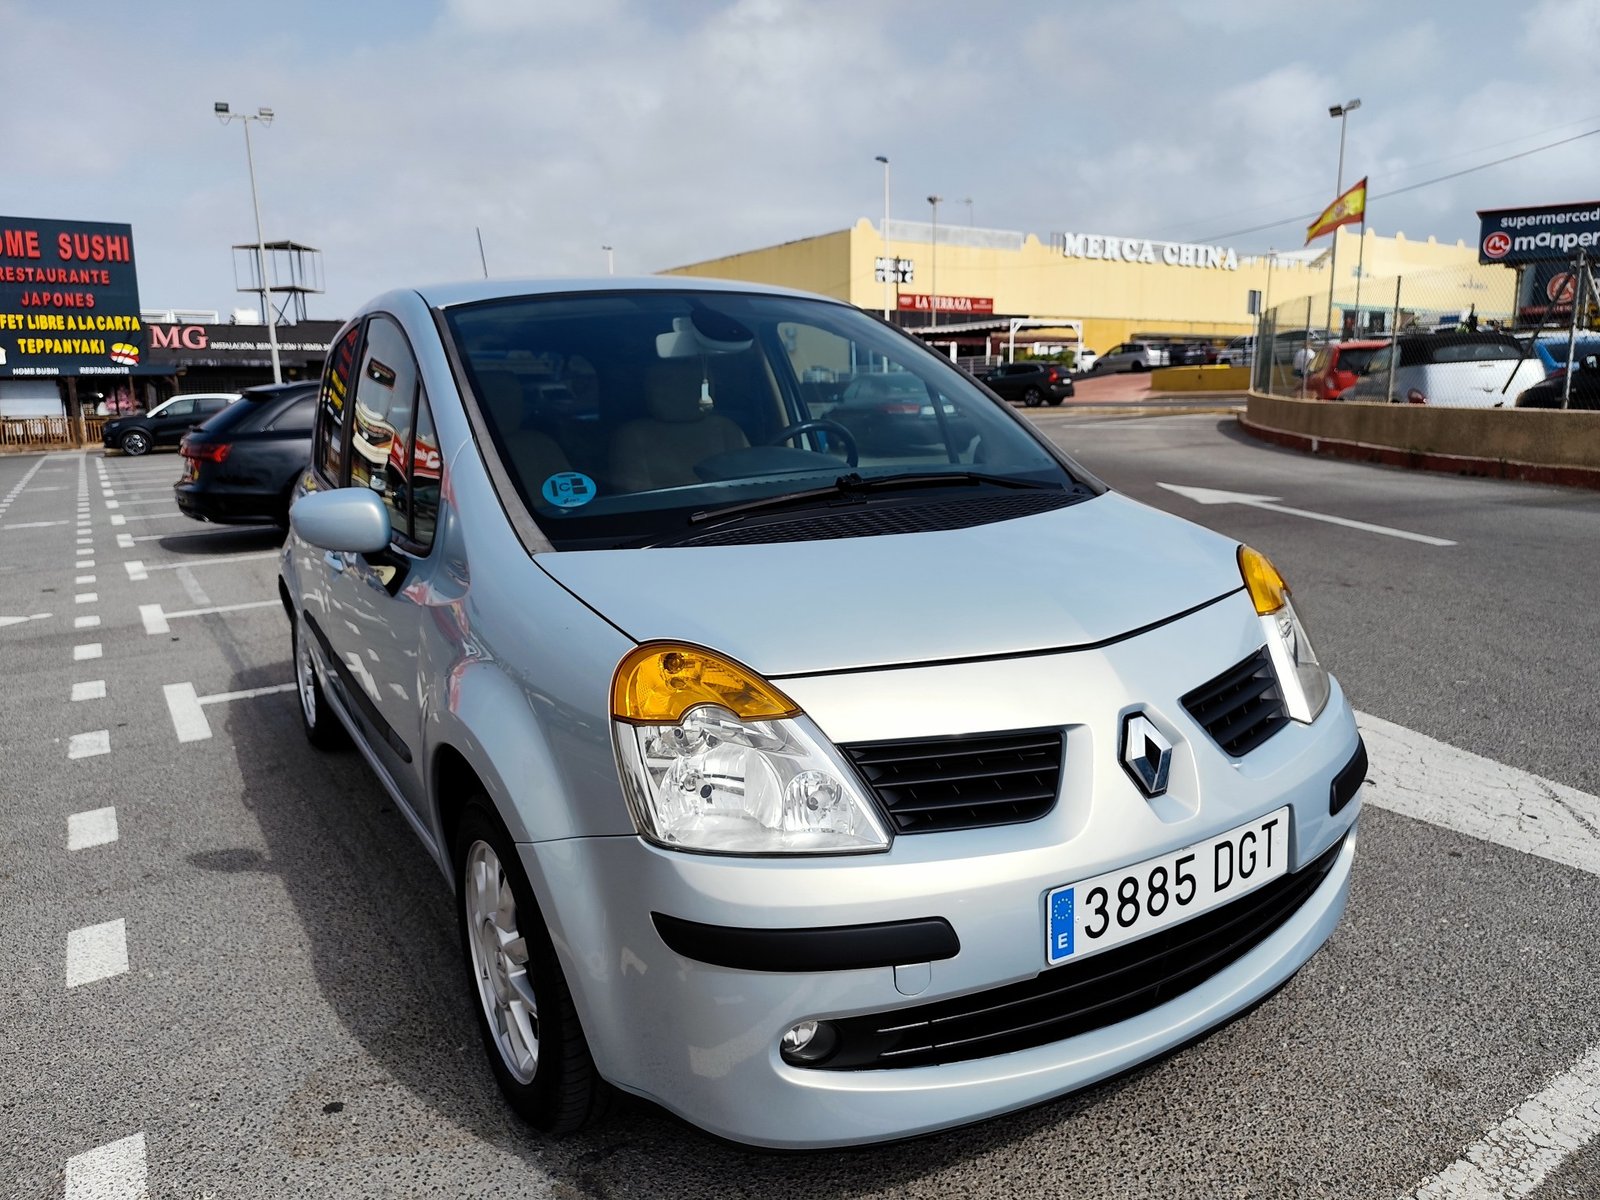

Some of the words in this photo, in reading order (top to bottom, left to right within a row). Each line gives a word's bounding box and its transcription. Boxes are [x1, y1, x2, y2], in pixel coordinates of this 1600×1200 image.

[1500, 208, 1600, 230] supermercad
[0, 229, 41, 259] ME
[58, 231, 130, 262] SUSHI
[1063, 232, 1155, 264] MERCA
[1162, 244, 1238, 271] CHINA
[21, 291, 95, 308] JAPONES
[914, 295, 929, 309] LA
[27, 314, 65, 331] LIBRE
[67, 315, 77, 331] A
[77, 315, 95, 331] LA
[96, 315, 141, 332] CARTA
[17, 338, 105, 355] TEPPANYAKI
[149, 325, 209, 350] MG
[12, 367, 35, 375] HOME
[36, 367, 59, 375] SUSHI
[79, 366, 129, 375] RESTAURANTE
[1084, 853, 1197, 939] 3885
[1213, 818, 1279, 893] DGT
[1058, 932, 1068, 949] E
